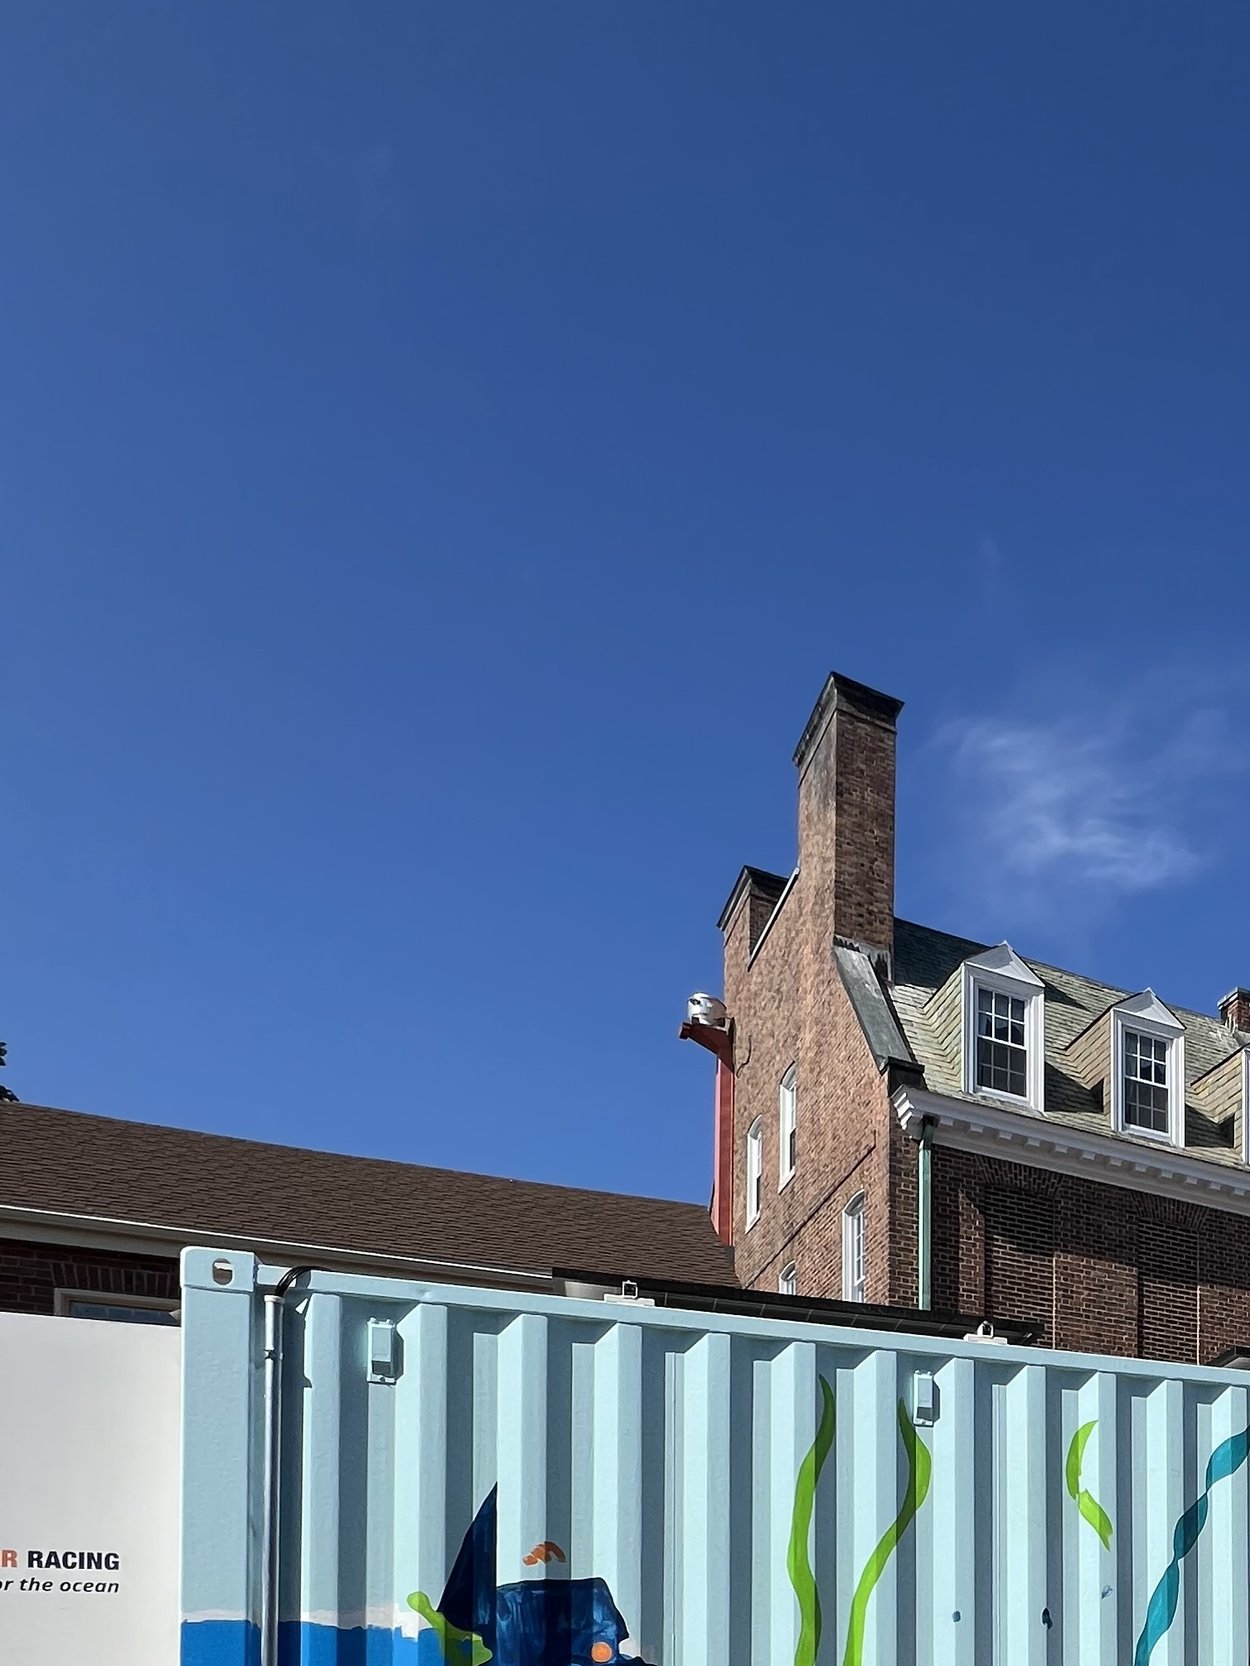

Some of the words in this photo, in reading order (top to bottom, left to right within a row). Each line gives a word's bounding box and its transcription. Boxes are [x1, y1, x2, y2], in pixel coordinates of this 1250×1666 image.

[28, 1550, 120, 1571] RACING
[20, 1577, 53, 1592] the
[59, 1581, 120, 1593] ocean
